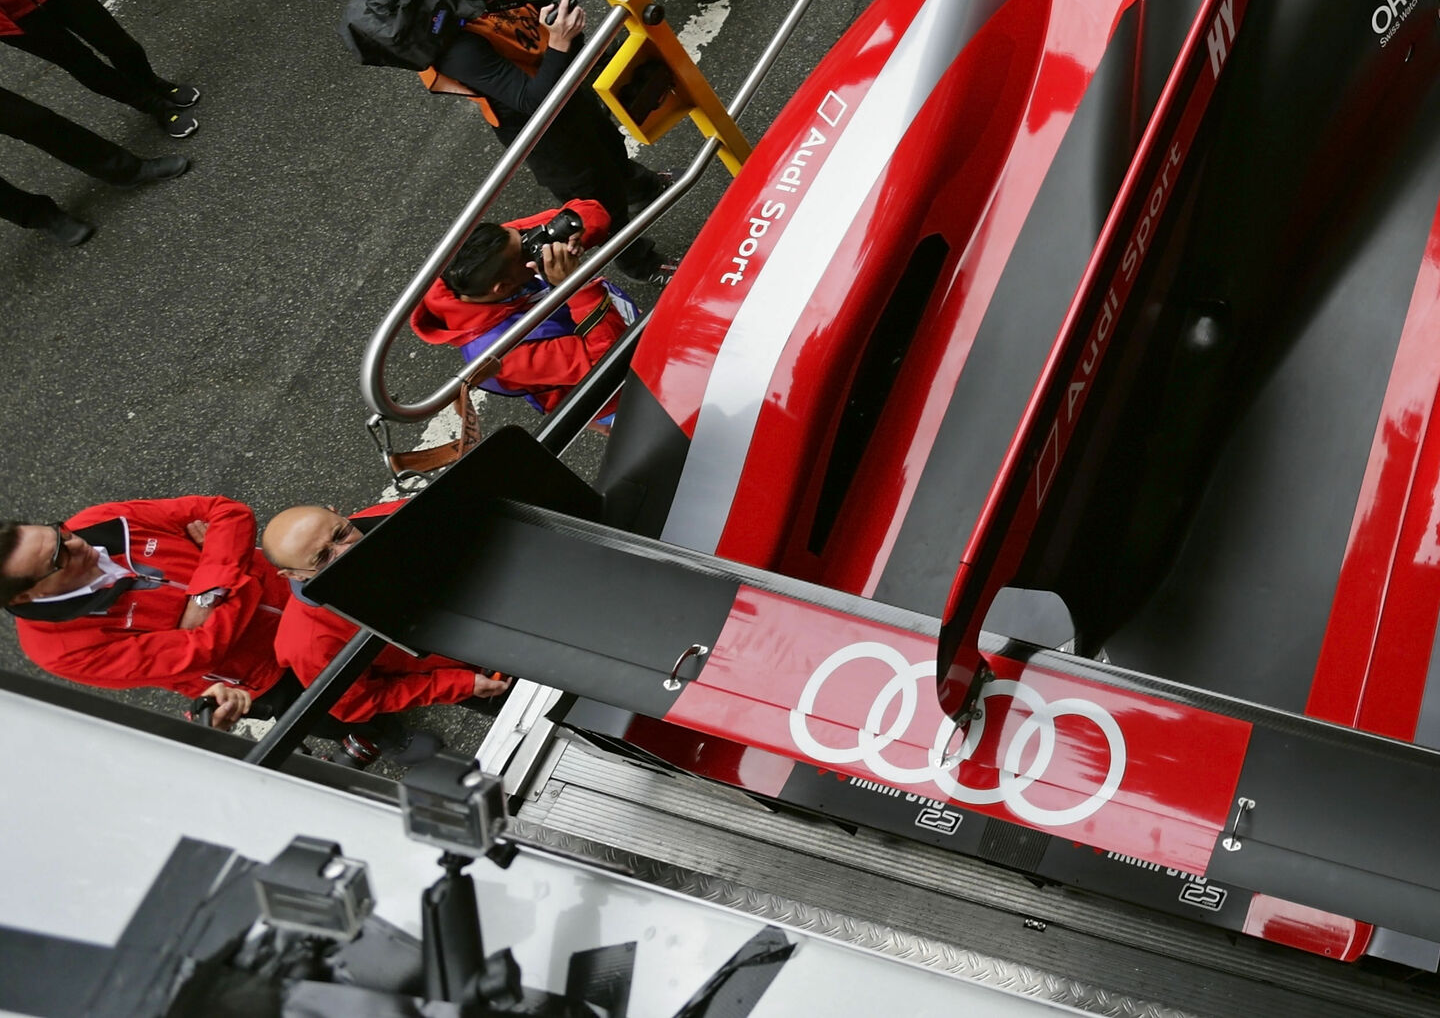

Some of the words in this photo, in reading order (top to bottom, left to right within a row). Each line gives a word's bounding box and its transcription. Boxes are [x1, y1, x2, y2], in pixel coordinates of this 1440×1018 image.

[1380, 21, 1401, 48] Swiss
[775, 126, 827, 194] Audi
[720, 199, 787, 287] Sport
[1067, 286, 1119, 423] Audi
[1120, 140, 1182, 283] Sport
[920, 808, 960, 827] 25
[1184, 883, 1224, 903] 25
